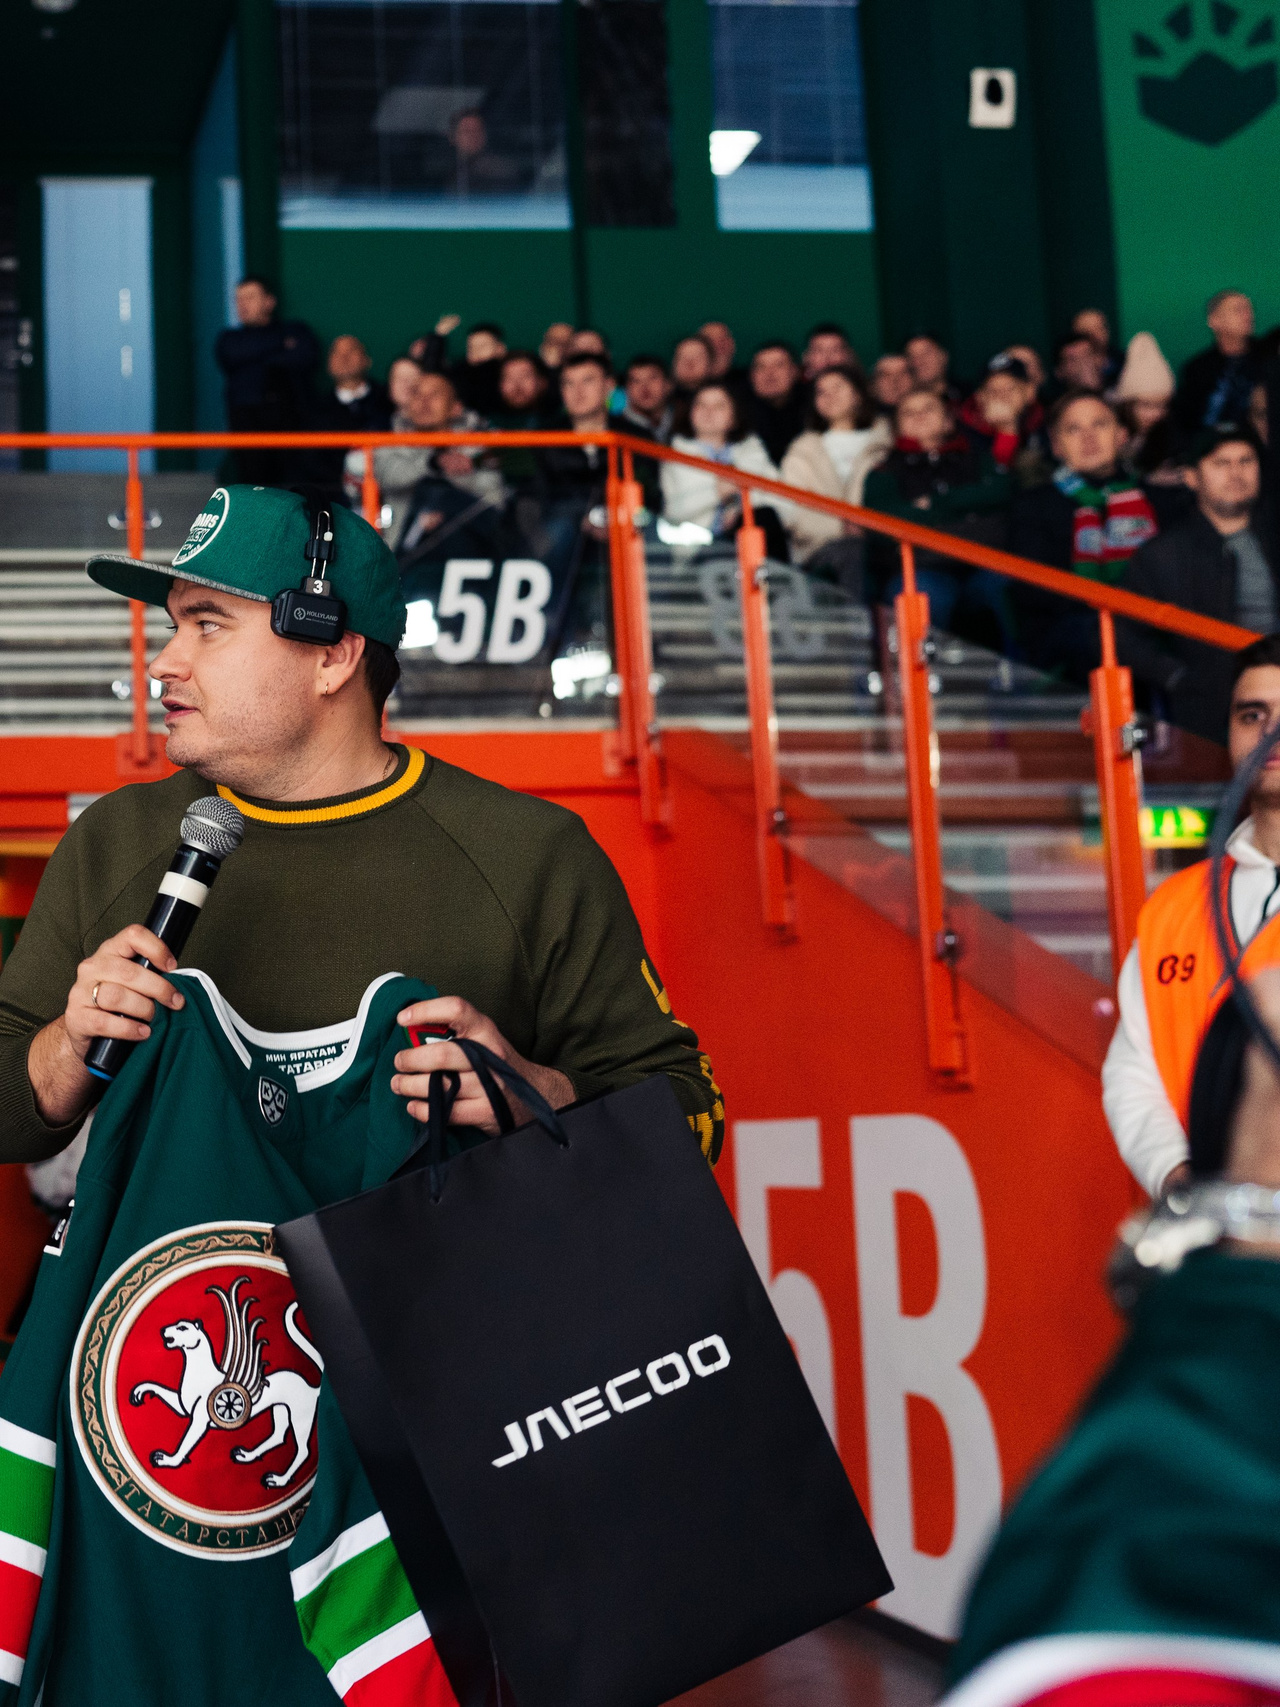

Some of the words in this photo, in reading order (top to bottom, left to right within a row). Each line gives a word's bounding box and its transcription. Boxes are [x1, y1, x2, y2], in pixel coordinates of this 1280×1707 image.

[313, 580, 324, 594] 3
[306, 610, 339, 622] HOLLYLAND
[432, 558, 552, 664] 5B
[265, 1053, 287, 1063] МИН
[289, 1045, 337, 1062] ЯРАТАМ
[491, 1334, 731, 1468] JAECOO
[124, 1483, 289, 1547] ТАТАРСТАН
